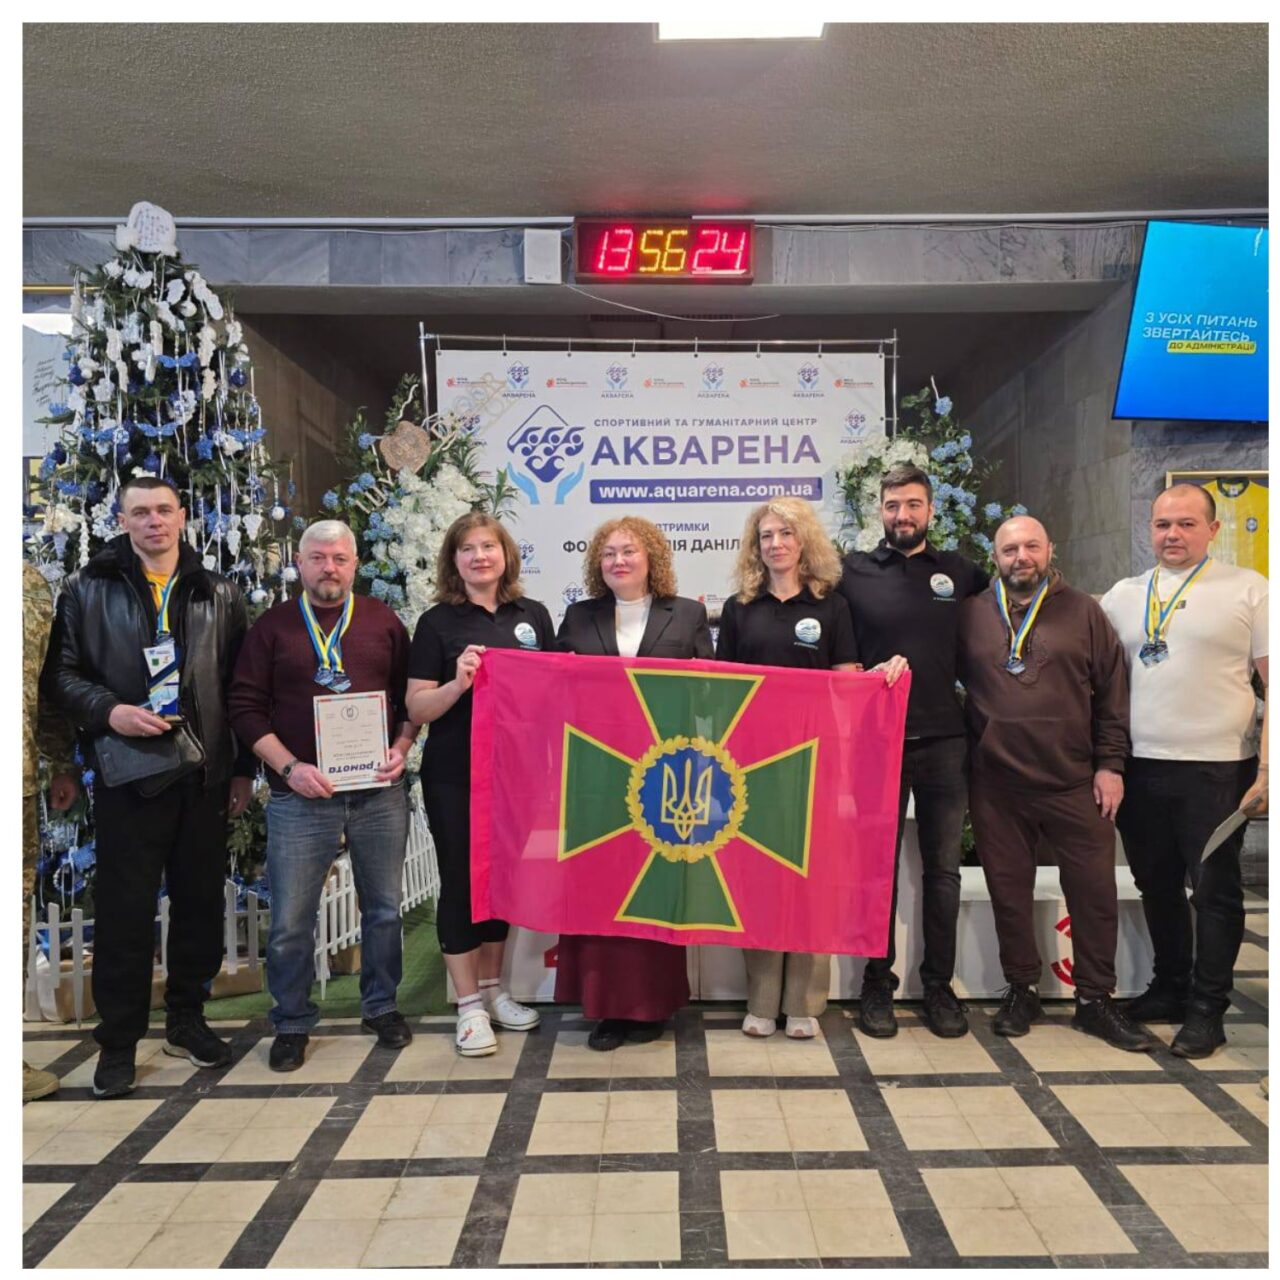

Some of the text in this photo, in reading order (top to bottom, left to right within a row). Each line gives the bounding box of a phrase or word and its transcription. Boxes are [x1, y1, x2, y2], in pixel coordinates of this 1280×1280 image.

[598, 229, 747, 272] 13 56 24
[1145, 312, 1258, 328] З УСІХ ПИТАНЬ
[1142, 326, 1250, 342] ЗВЕРТАЙТЕСЬ
[1168, 341, 1184, 350] ДО
[594, 416, 818, 428] СПОРТИВНИЙ ТА ГУМАНІТАРНИЙ ЦЕНТР
[590, 434, 821, 466] АКВАРЕНА
[599, 483, 813, 501] www.aquarena.com.ua
[690, 539, 740, 553] ДАНІЛ
